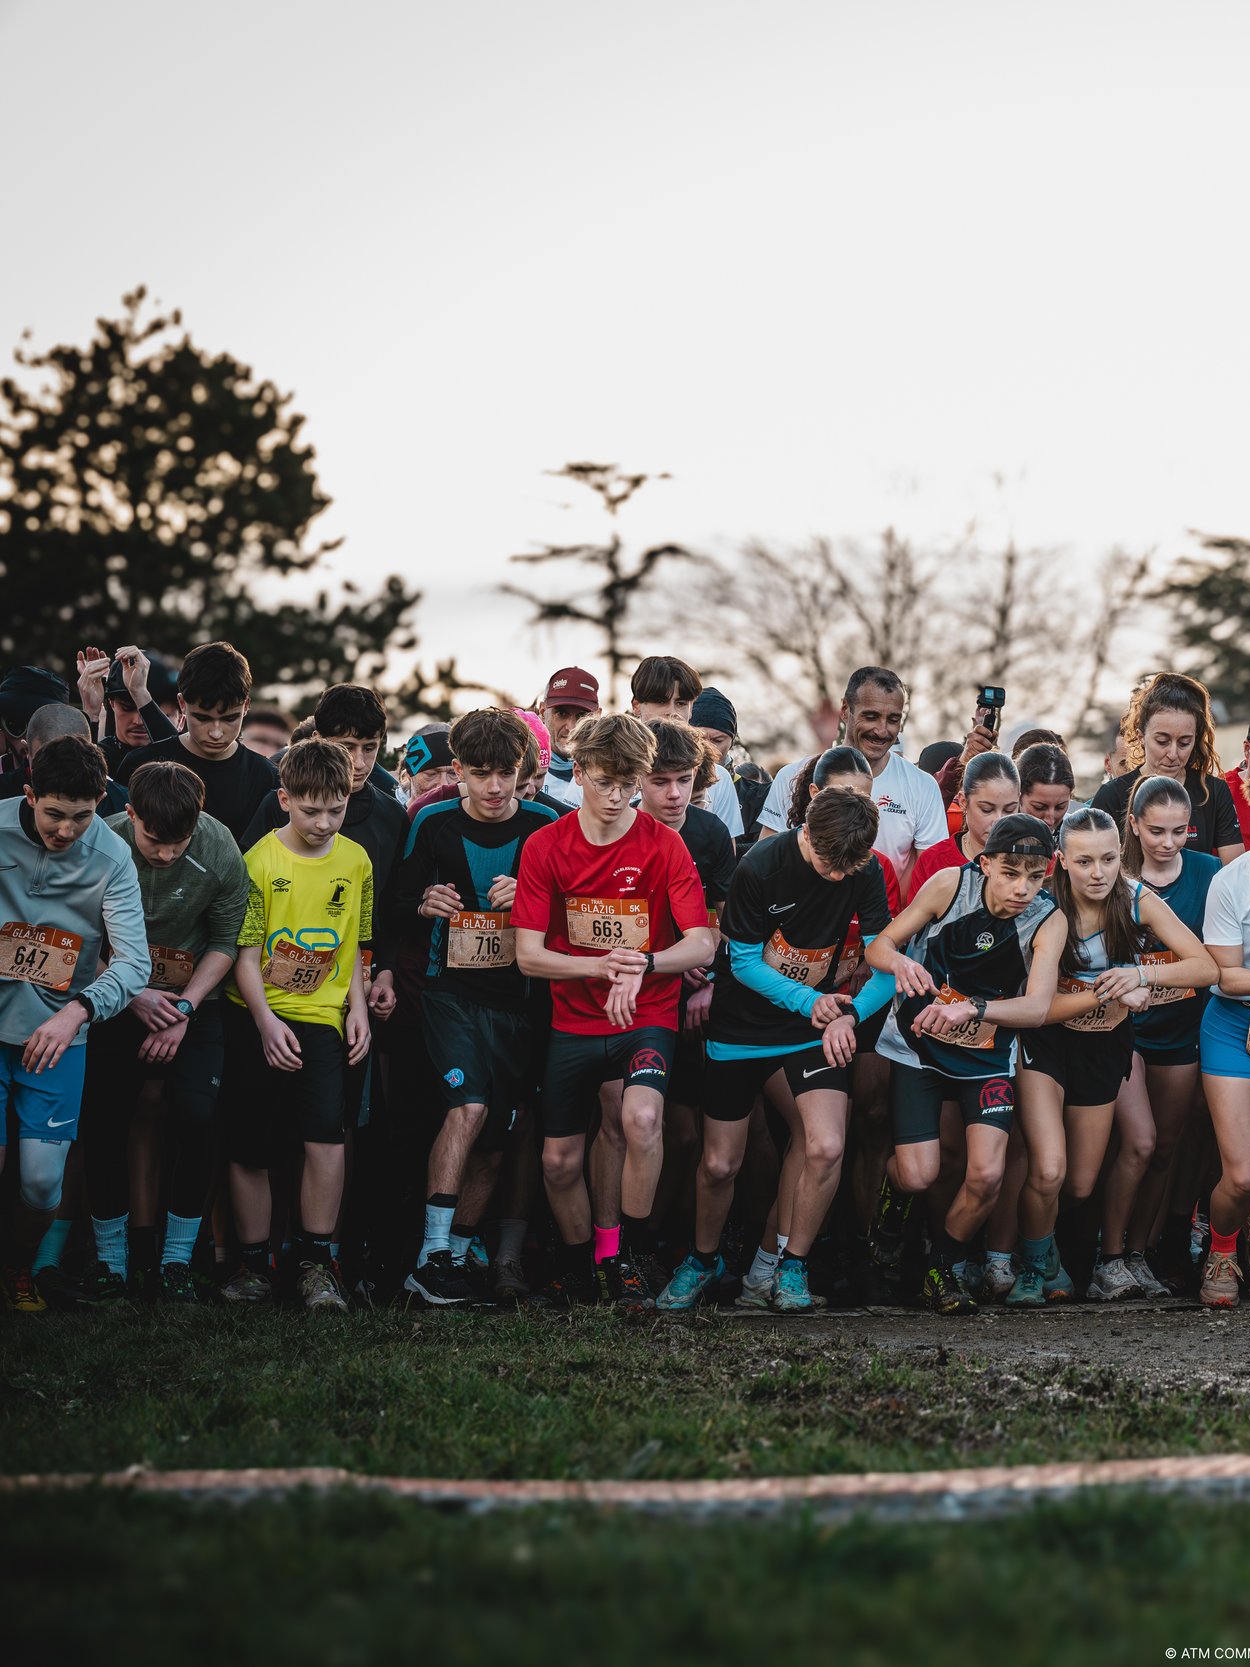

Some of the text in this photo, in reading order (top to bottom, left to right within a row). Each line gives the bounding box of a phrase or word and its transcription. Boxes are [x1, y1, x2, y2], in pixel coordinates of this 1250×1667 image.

[581, 903, 615, 914] GLAZIG
[462, 919, 496, 929] GLAZIG
[592, 920, 622, 938] 663
[61, 937, 73, 948] 5K
[475, 936, 501, 955] 716
[591, 936, 628, 945] KINETIK
[14, 946, 50, 971] 647
[288, 950, 322, 965] GLAZIG
[470, 954, 505, 962] KINETIK
[776, 944, 831, 962] GLAZIG 5K
[8, 965, 49, 979] KINETIK
[292, 967, 321, 985] 551
[780, 962, 810, 981] 589
[1150, 989, 1176, 999] INETIK
[1071, 1018, 1106, 1026] KINETIK
[630, 1068, 666, 1079] KINETIK
